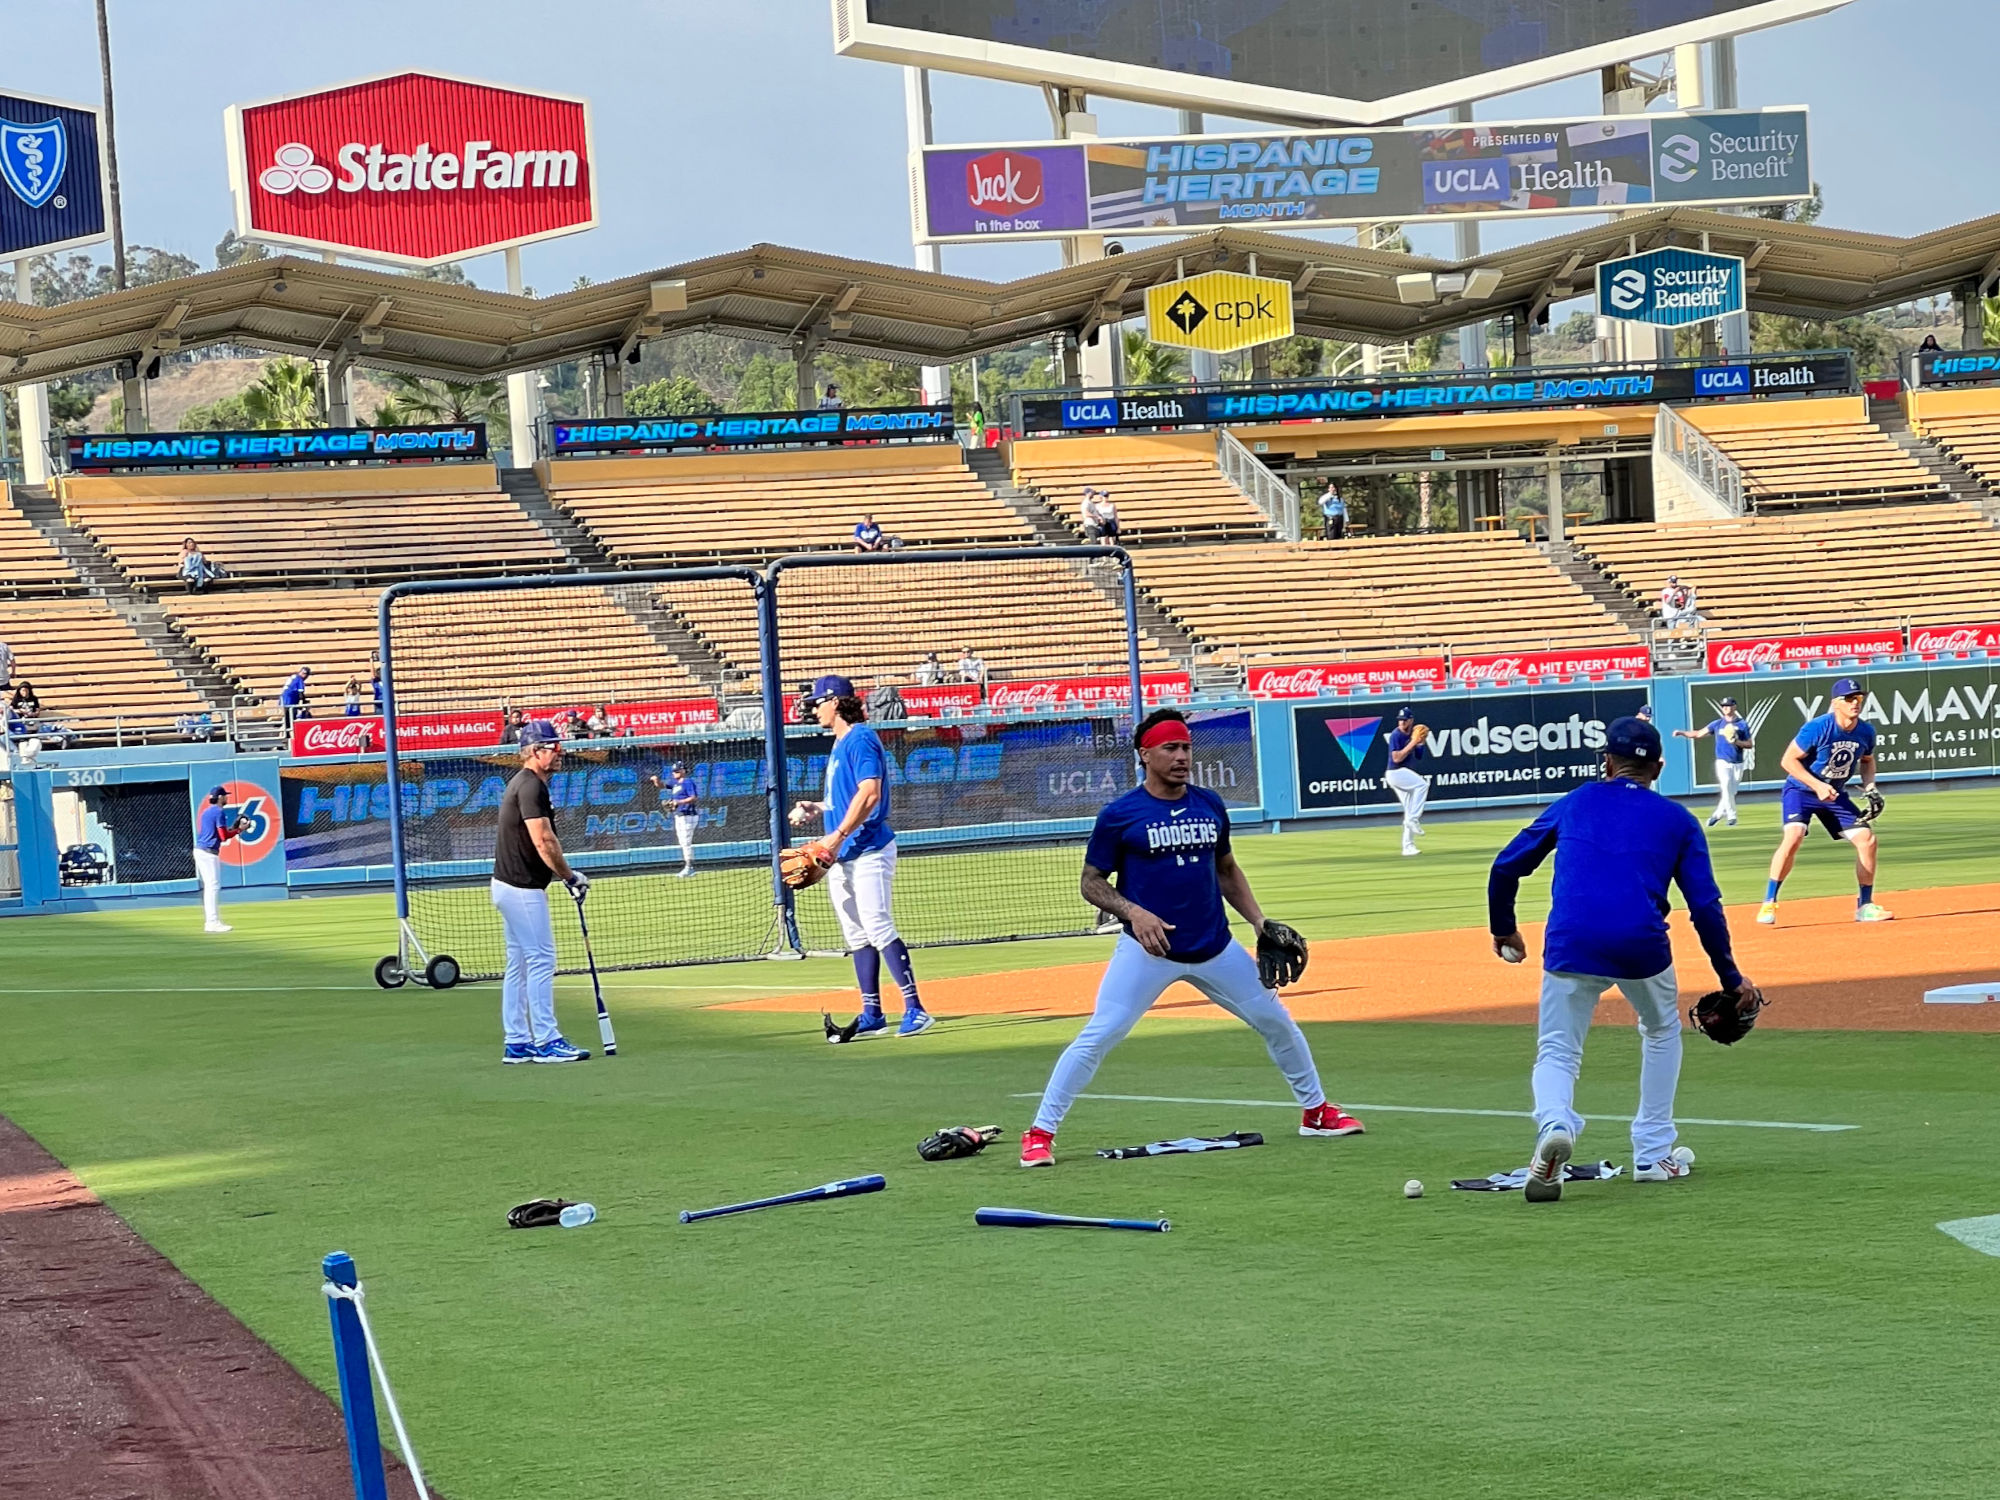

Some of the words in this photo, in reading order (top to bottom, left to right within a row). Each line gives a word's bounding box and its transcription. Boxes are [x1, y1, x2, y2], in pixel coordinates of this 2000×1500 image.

[1473, 133, 1541, 147] PRESENTED
[1546, 132, 1559, 144] BY
[1709, 130, 1799, 162] Security
[1146, 137, 1375, 173] HISPANIC
[970, 157, 1040, 205] Jack
[1434, 168, 1500, 193] UCLA
[1518, 160, 1614, 191] Health
[1712, 156, 1789, 182] Benefit
[1142, 167, 1381, 204] HERITAGE
[1219, 201, 1305, 219] MONTH
[975, 220, 987, 232] in
[990, 219, 1011, 232] the
[1014, 218, 1040, 231] box
[1653, 265, 1731, 288] Security
[1215, 293, 1275, 327] cpk
[1655, 287, 1722, 309] Benefit
[1702, 371, 1743, 389] UCLA
[1754, 366, 1815, 388] Health
[1224, 390, 1373, 416] HISPANIC
[1379, 380, 1535, 408] HERITAGE
[1542, 375, 1654, 398] MONTH
[1069, 405, 1111, 421] UCLA
[1122, 400, 1183, 420] Health
[569, 421, 699, 443] HISPANIC
[704, 416, 839, 438] HERITAGE
[846, 412, 942, 432] MONTH
[83, 436, 220, 459] HISPANIC
[226, 432, 368, 457] HERITAGE
[375, 429, 475, 450] MONTH
[1527, 663, 1538, 674] A
[1540, 661, 1563, 673] HIT
[1567, 659, 1610, 672] EVERY
[1612, 656, 1646, 668] TIME
[1717, 642, 1783, 668] Coca-Cola
[1786, 646, 1823, 658] HOME
[1826, 644, 1851, 656] RUN
[1854, 641, 1894, 654] MAGIC
[1065, 688, 1076, 700] A
[1078, 687, 1101, 699] HIT
[1105, 684, 1150, 699] EVEY
[1152, 682, 1187, 695] TIME
[1259, 668, 1326, 693] Coca-Cola
[1329, 672, 1367, 684] HOME
[1369, 670, 1394, 683] RUN
[1397, 668, 1437, 681] MAGIC
[931, 694, 973, 707] MAGIC
[422, 724, 450, 736] RUN
[452, 722, 496, 734] MAGIC
[631, 712, 678, 725] EVERY
[680, 710, 716, 722] TIME
[1910, 733, 1920, 744] &
[1878, 751, 1907, 762] SAN
[1915, 747, 1977, 760] MANUEL
[68, 769, 105, 786] 360
[1049, 769, 1117, 796] UCLA
[1309, 777, 1377, 794] OFFICIAL
[1437, 768, 1541, 786] MARKETPLACE
[1545, 766, 1566, 780] OF
[1569, 764, 1597, 779] THE
[585, 807, 728, 837] MONH
[1147, 823, 1217, 849] DODGERS
